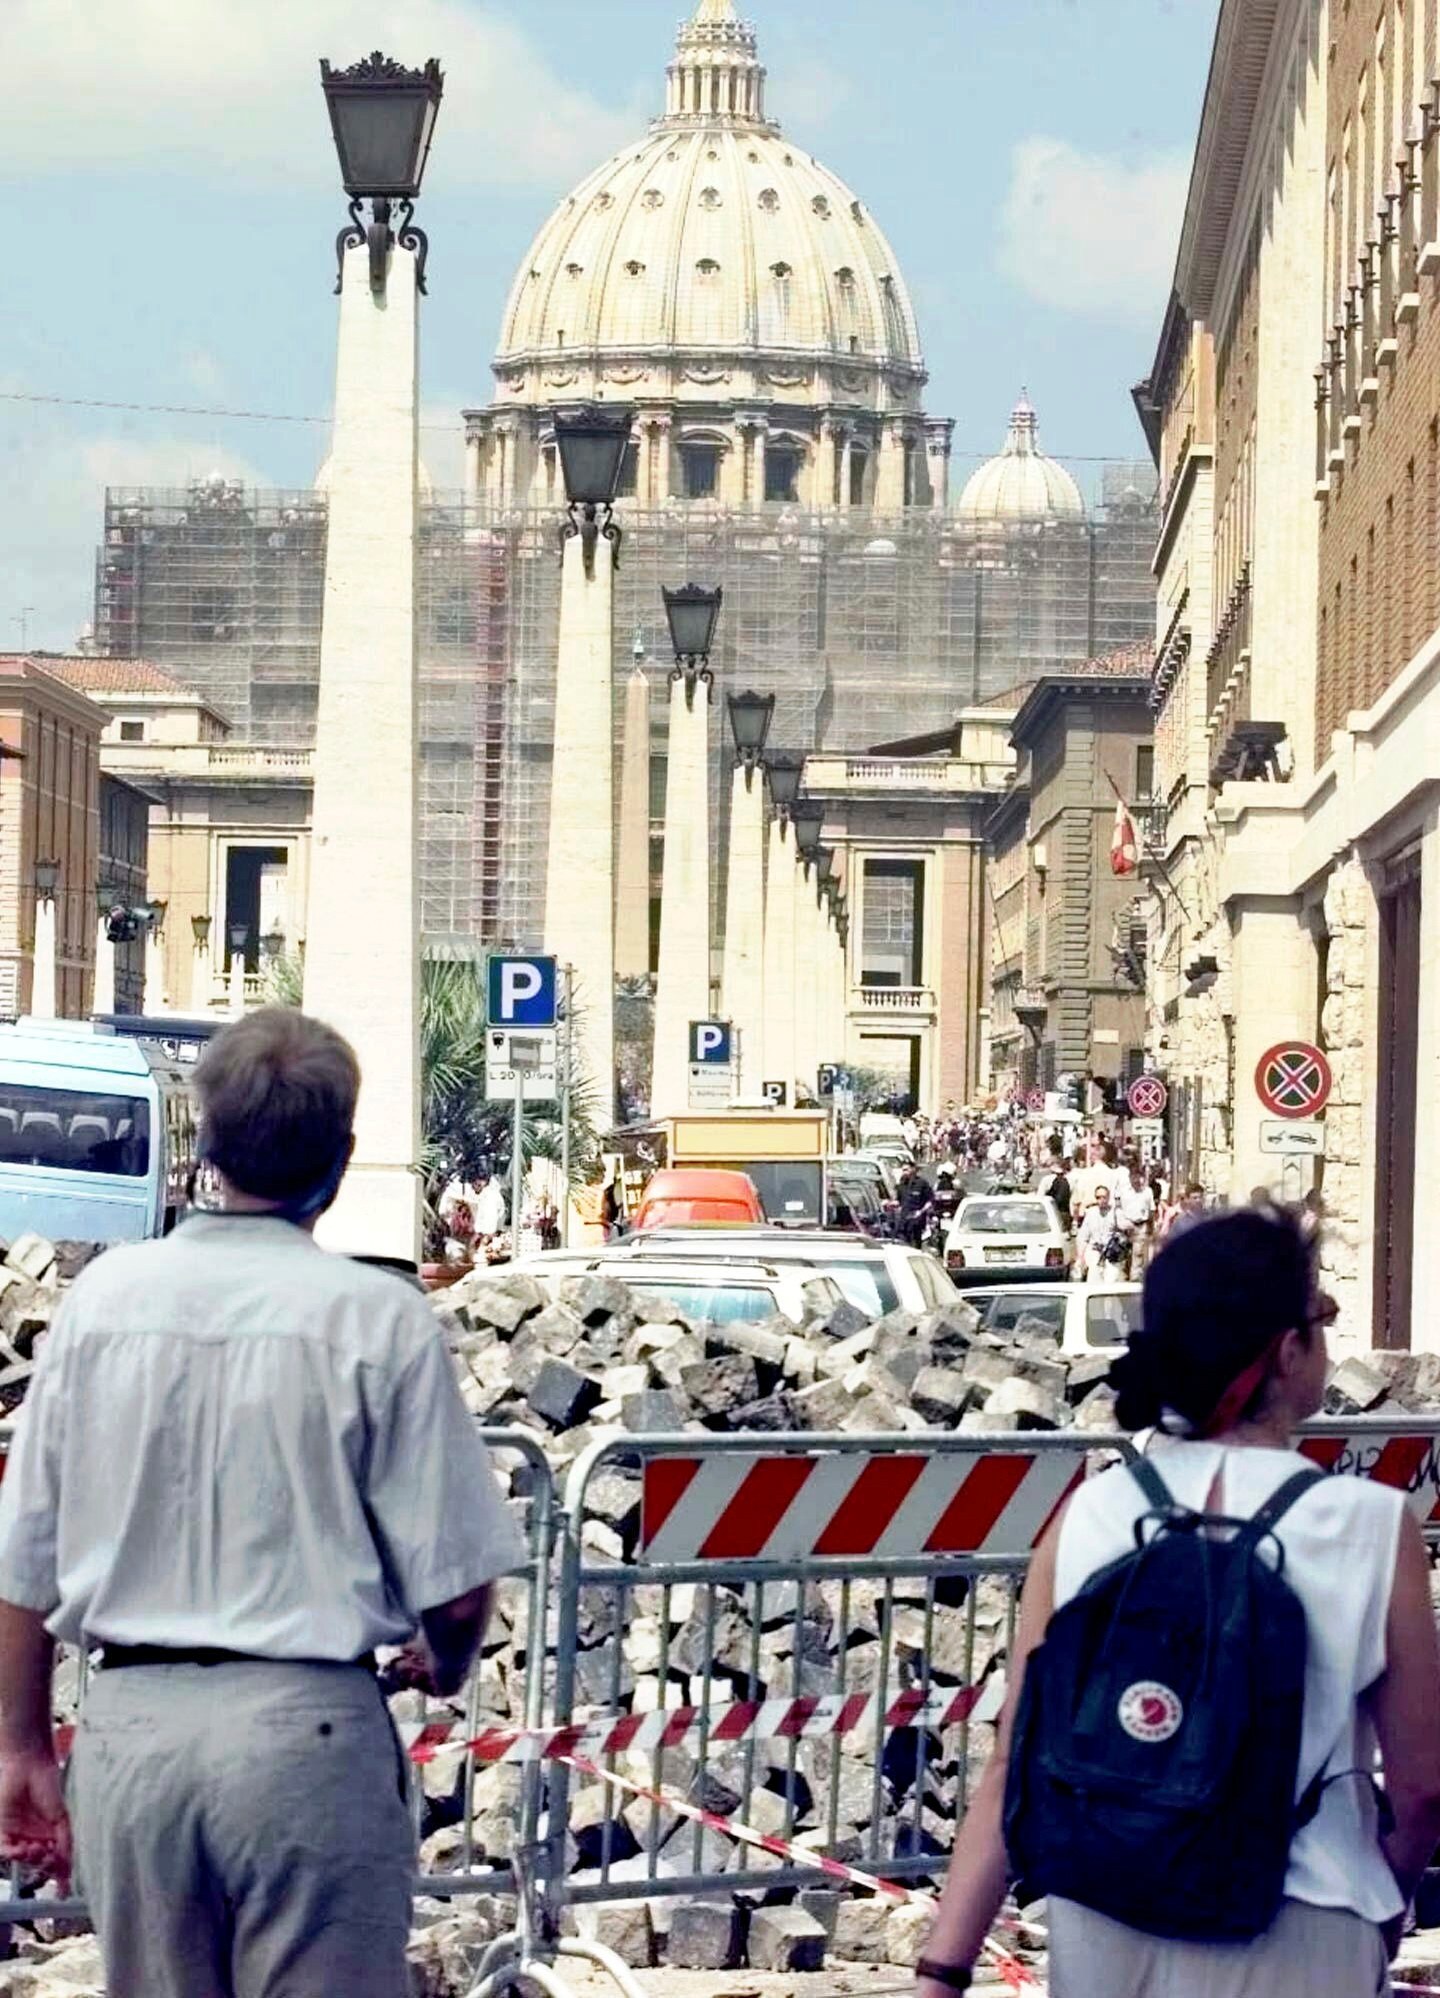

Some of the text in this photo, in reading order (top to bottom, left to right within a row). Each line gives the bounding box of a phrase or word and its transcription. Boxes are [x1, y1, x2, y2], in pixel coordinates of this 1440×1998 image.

[501, 962, 542, 1019] P
[696, 1025, 723, 1060] P
[766, 1083, 783, 1100] P
